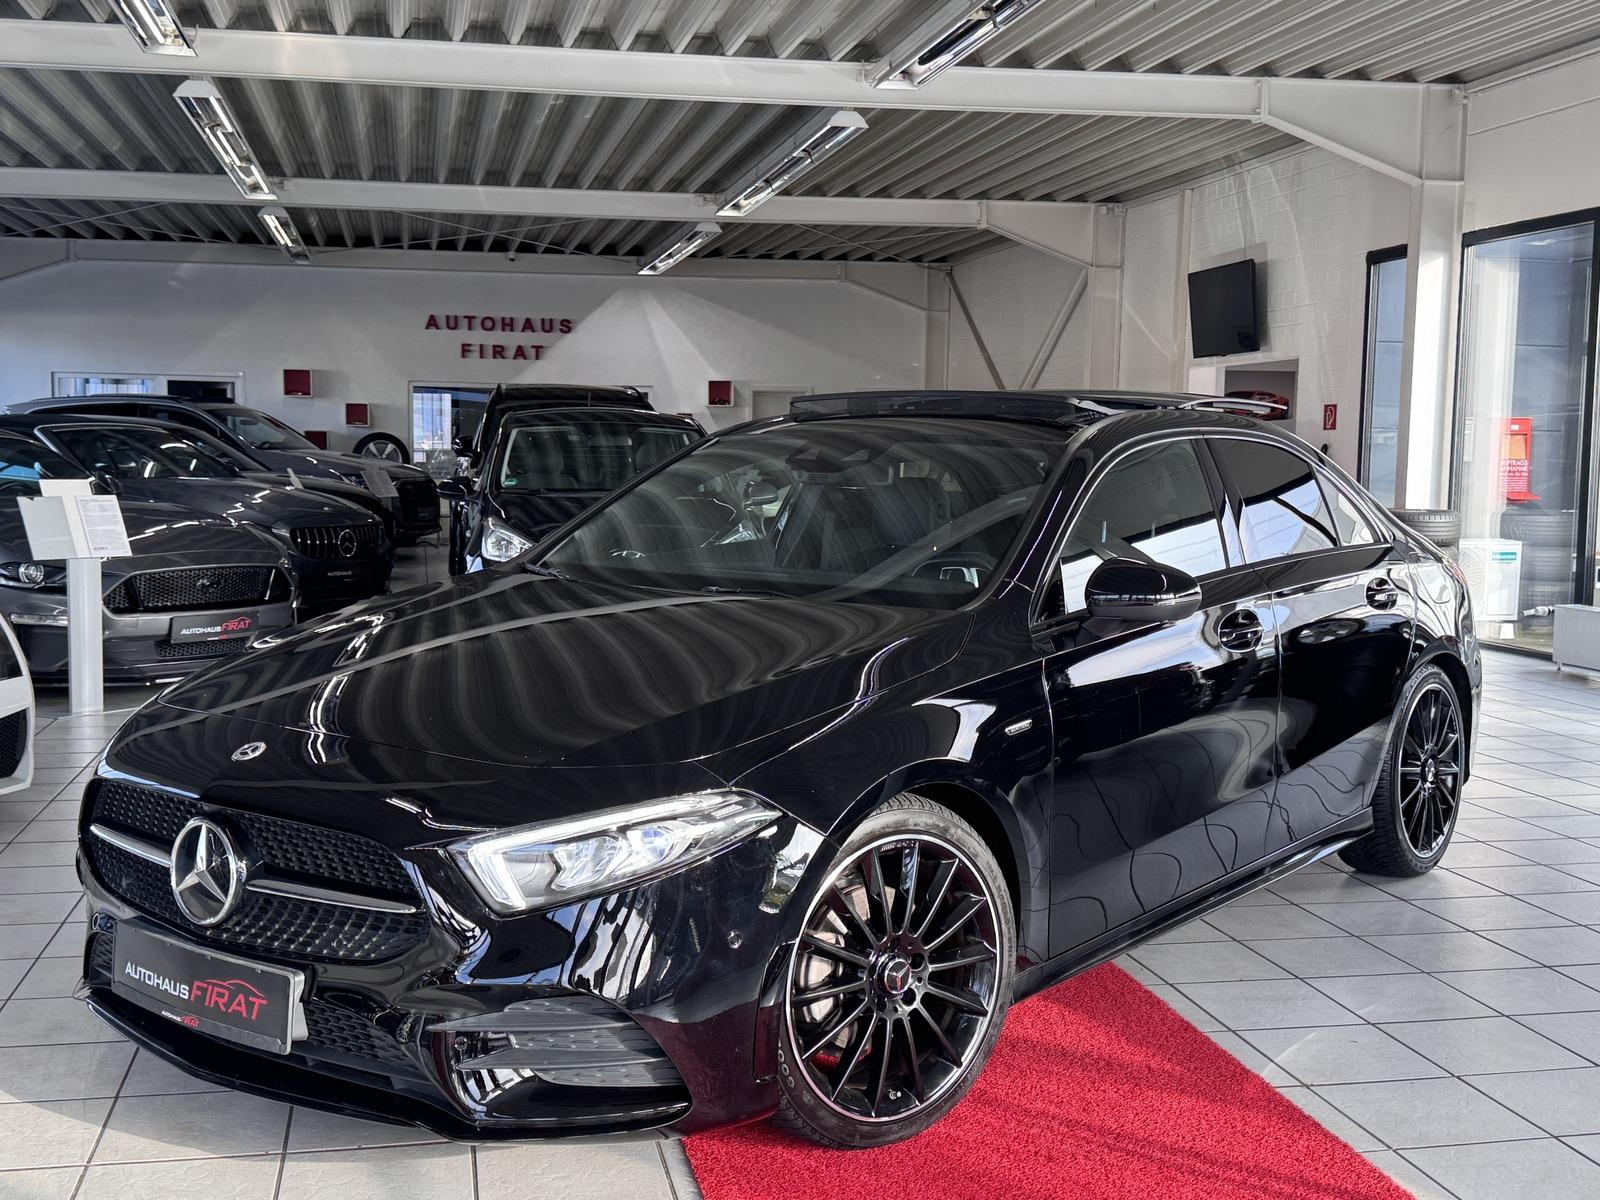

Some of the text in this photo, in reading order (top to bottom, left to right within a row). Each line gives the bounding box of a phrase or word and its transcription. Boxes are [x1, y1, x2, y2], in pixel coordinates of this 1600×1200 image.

[425, 314, 572, 334] AUTOHAUS
[461, 343, 544, 360] FIRAT
[180, 620, 251, 635] AUTOHAUS FIRAT
[125, 961, 268, 1020] AUTOHAUS FIRAT
